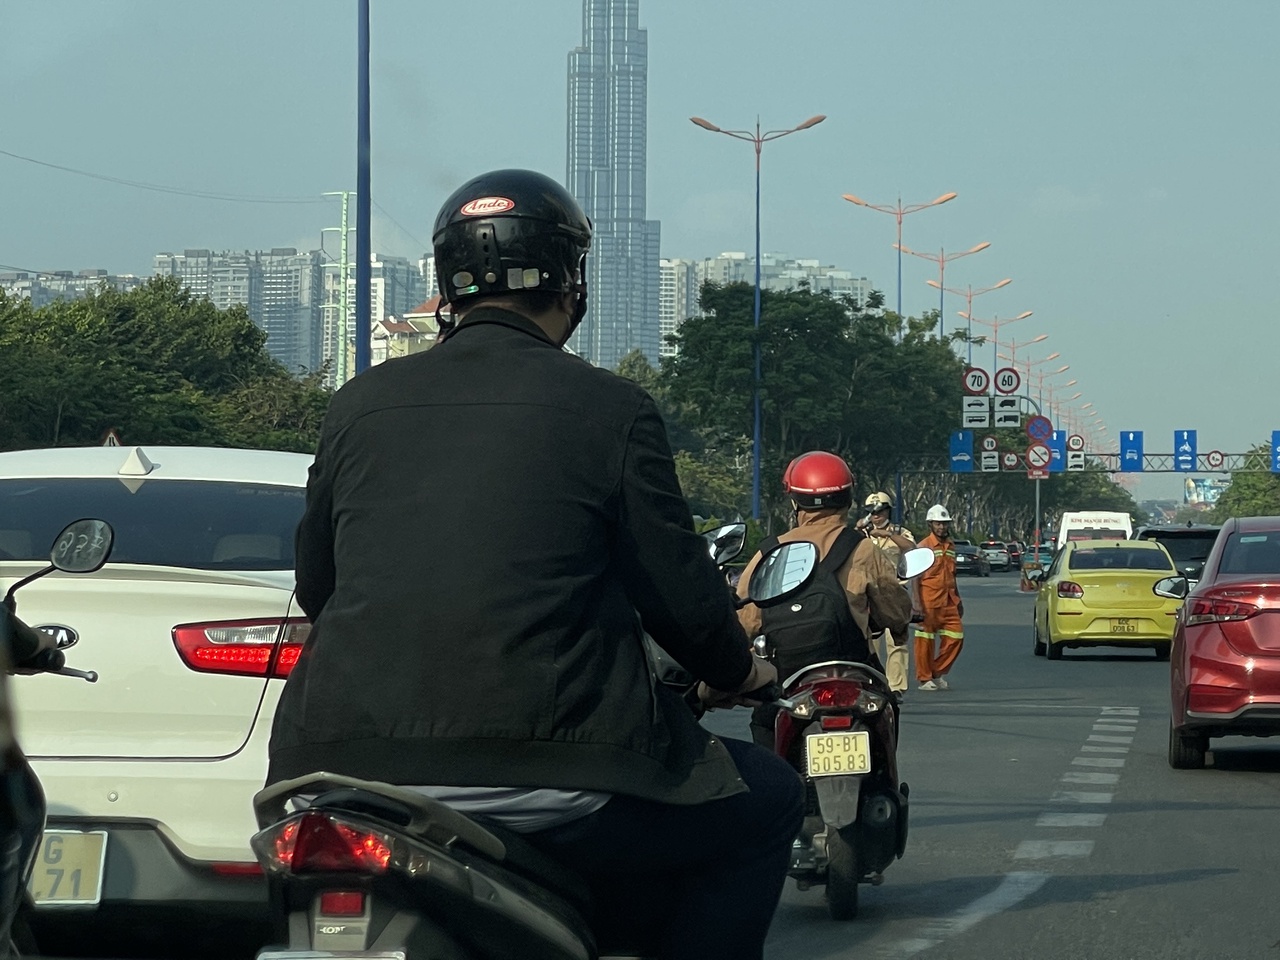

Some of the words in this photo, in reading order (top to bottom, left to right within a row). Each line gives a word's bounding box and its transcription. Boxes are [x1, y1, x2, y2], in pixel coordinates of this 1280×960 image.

[971, 375, 983, 387] 70
[1001, 375, 1013, 386] 60
[816, 735, 858, 754] 59-B1
[812, 753, 866, 773] 505.83
